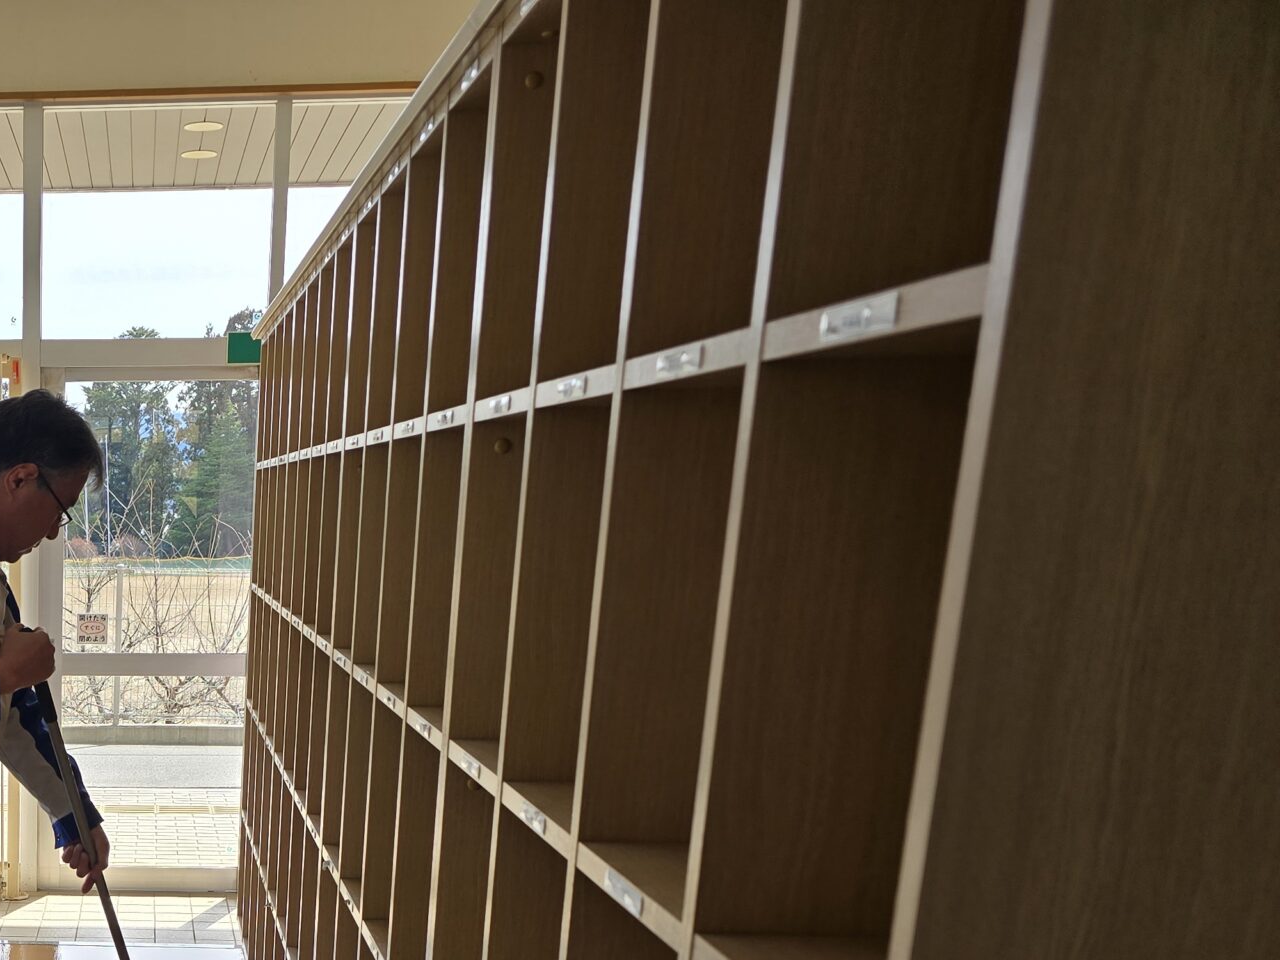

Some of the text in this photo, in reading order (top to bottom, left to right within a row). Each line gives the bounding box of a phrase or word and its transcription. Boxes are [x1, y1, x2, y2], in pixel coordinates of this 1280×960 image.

[78, 614, 106, 622] 開けたら
[78, 635, 106, 643] 閉めよう
